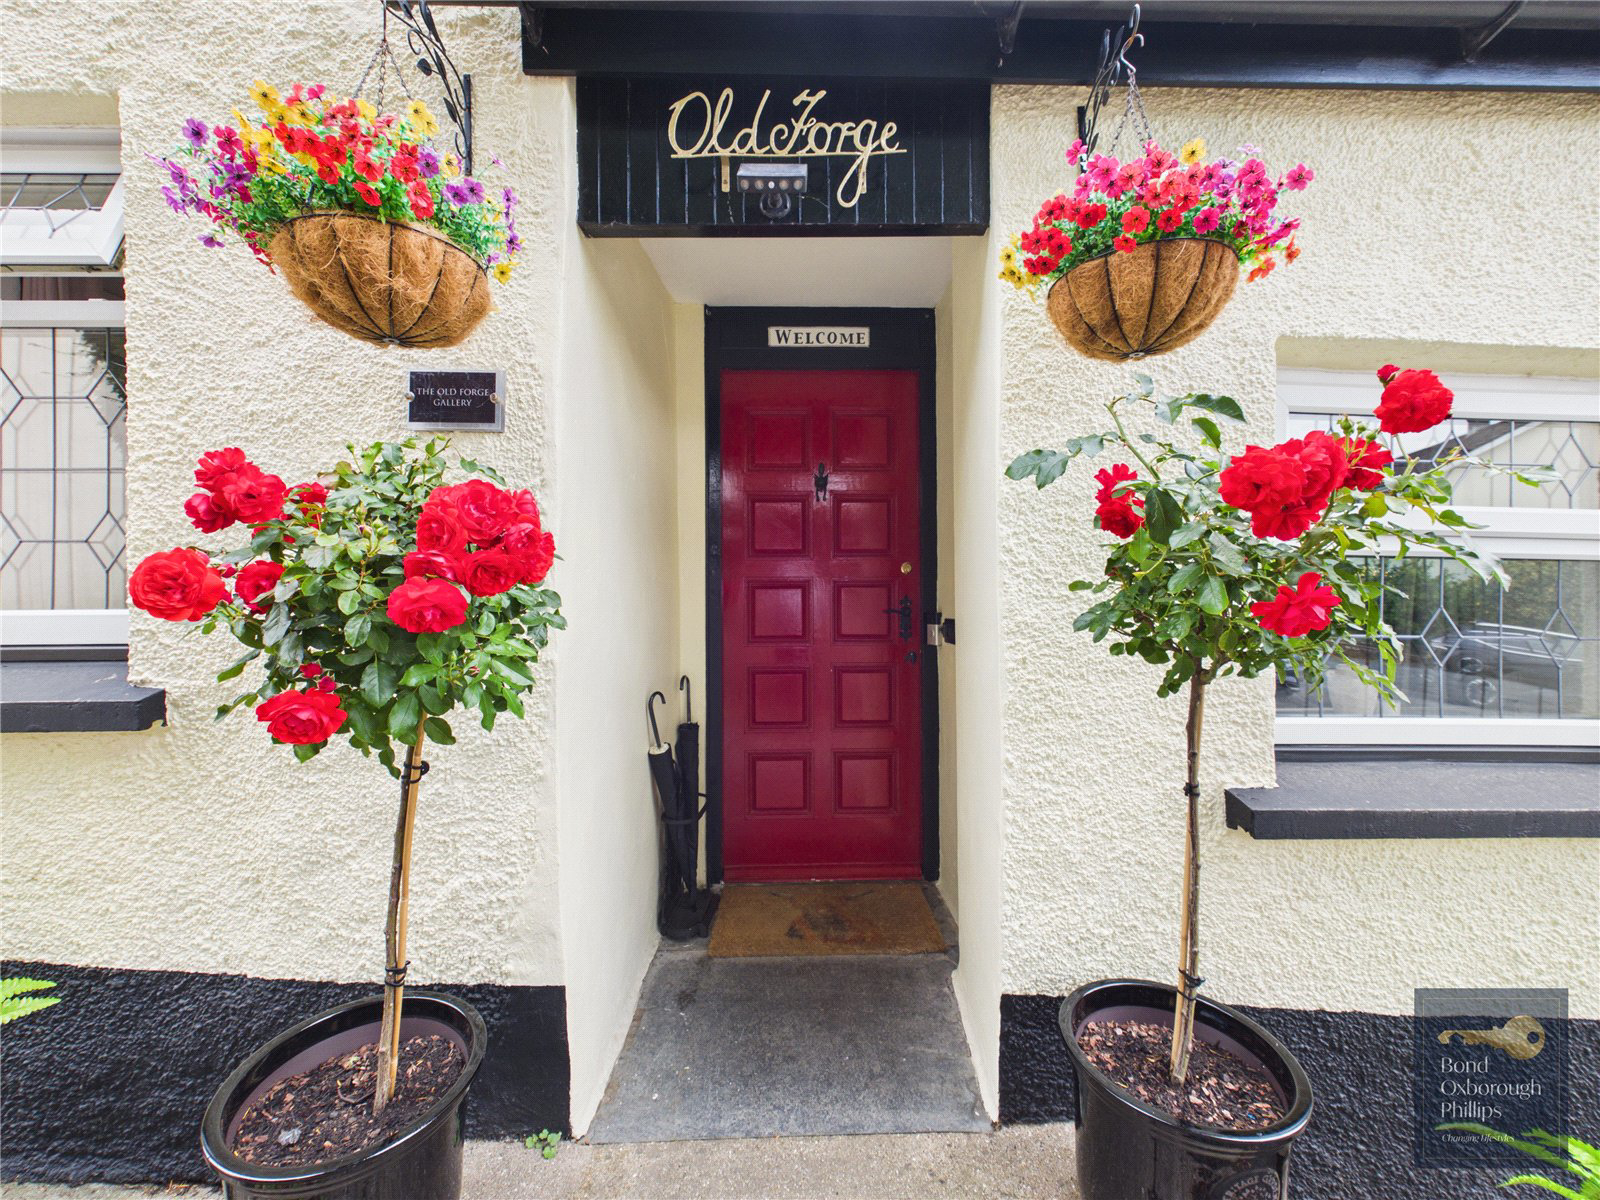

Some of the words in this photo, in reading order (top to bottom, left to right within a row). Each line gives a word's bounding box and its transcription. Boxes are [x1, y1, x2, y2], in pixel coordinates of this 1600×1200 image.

[668, 87, 770, 154] Old
[769, 89, 900, 208] Forge
[775, 329, 866, 345] WELCOME
[417, 388, 435, 396] THE
[436, 388, 457, 396] OLD
[459, 388, 489, 397] FORGE
[433, 399, 472, 407] GALLERY
